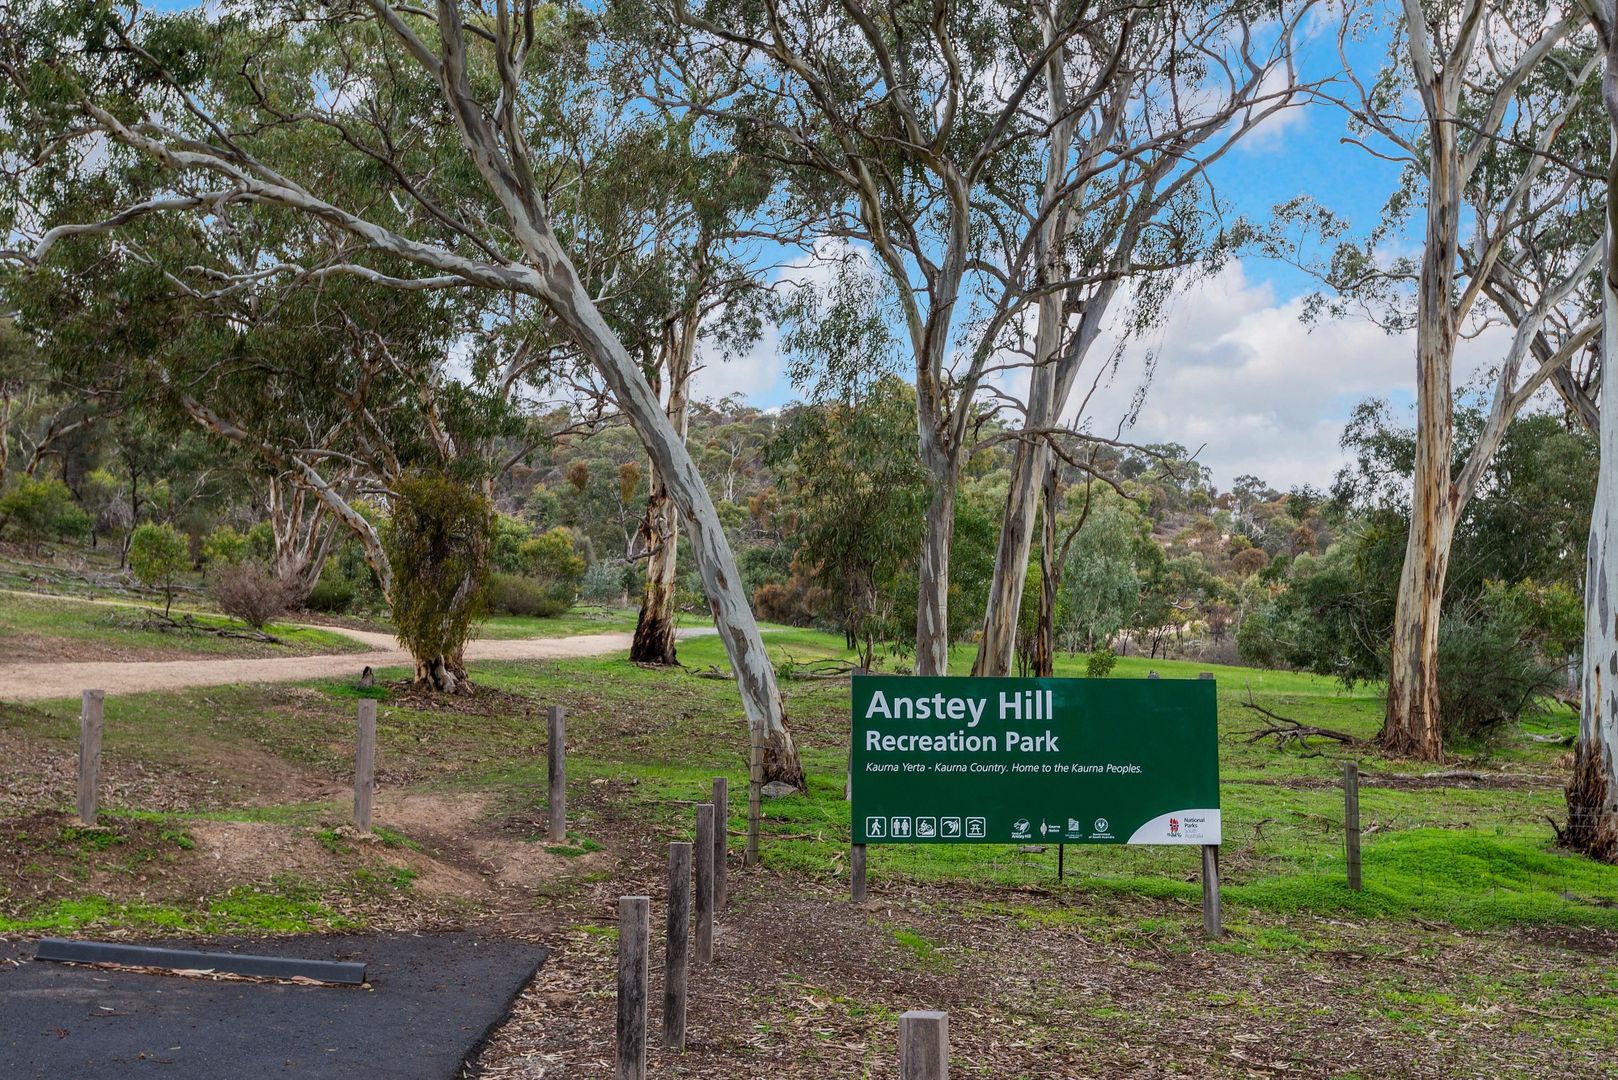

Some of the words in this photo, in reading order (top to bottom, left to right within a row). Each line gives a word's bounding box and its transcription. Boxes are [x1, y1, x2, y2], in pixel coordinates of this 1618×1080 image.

[865, 690, 987, 728] Anstey
[999, 690, 1053, 720] Hill
[866, 730, 997, 752] Recreation
[1005, 730, 1060, 752] Park
[865, 762, 899, 772] Kaurna
[902, 762, 926, 772] Yerta
[934, 762, 967, 772] Kaurna
[969, 762, 1009, 775] Country.
[1011, 763, 1040, 773] Home
[1041, 763, 1052, 773] to
[1053, 763, 1070, 773] the
[1071, 763, 1104, 773] Kaurna
[1106, 763, 1143, 775] Peoples.
